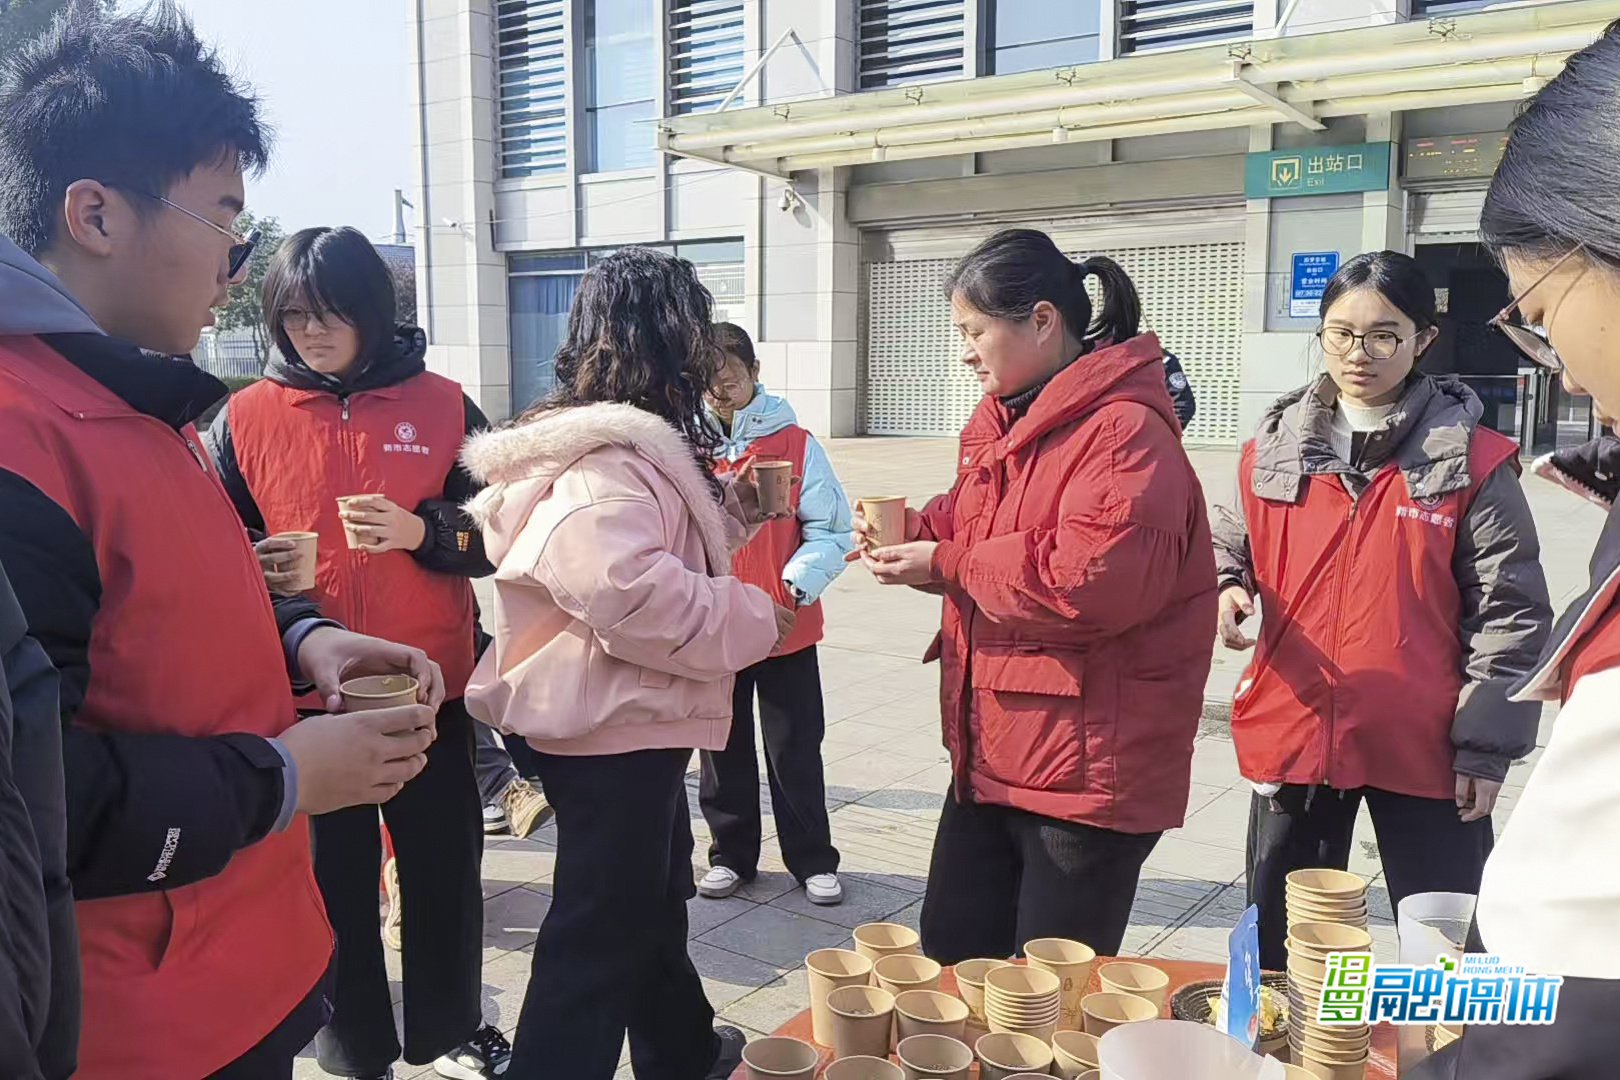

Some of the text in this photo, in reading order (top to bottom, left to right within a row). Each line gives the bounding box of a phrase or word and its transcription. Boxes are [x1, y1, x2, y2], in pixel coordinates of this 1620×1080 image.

[1308, 154, 1363, 174] 出站口
[1307, 177, 1325, 187] Exit
